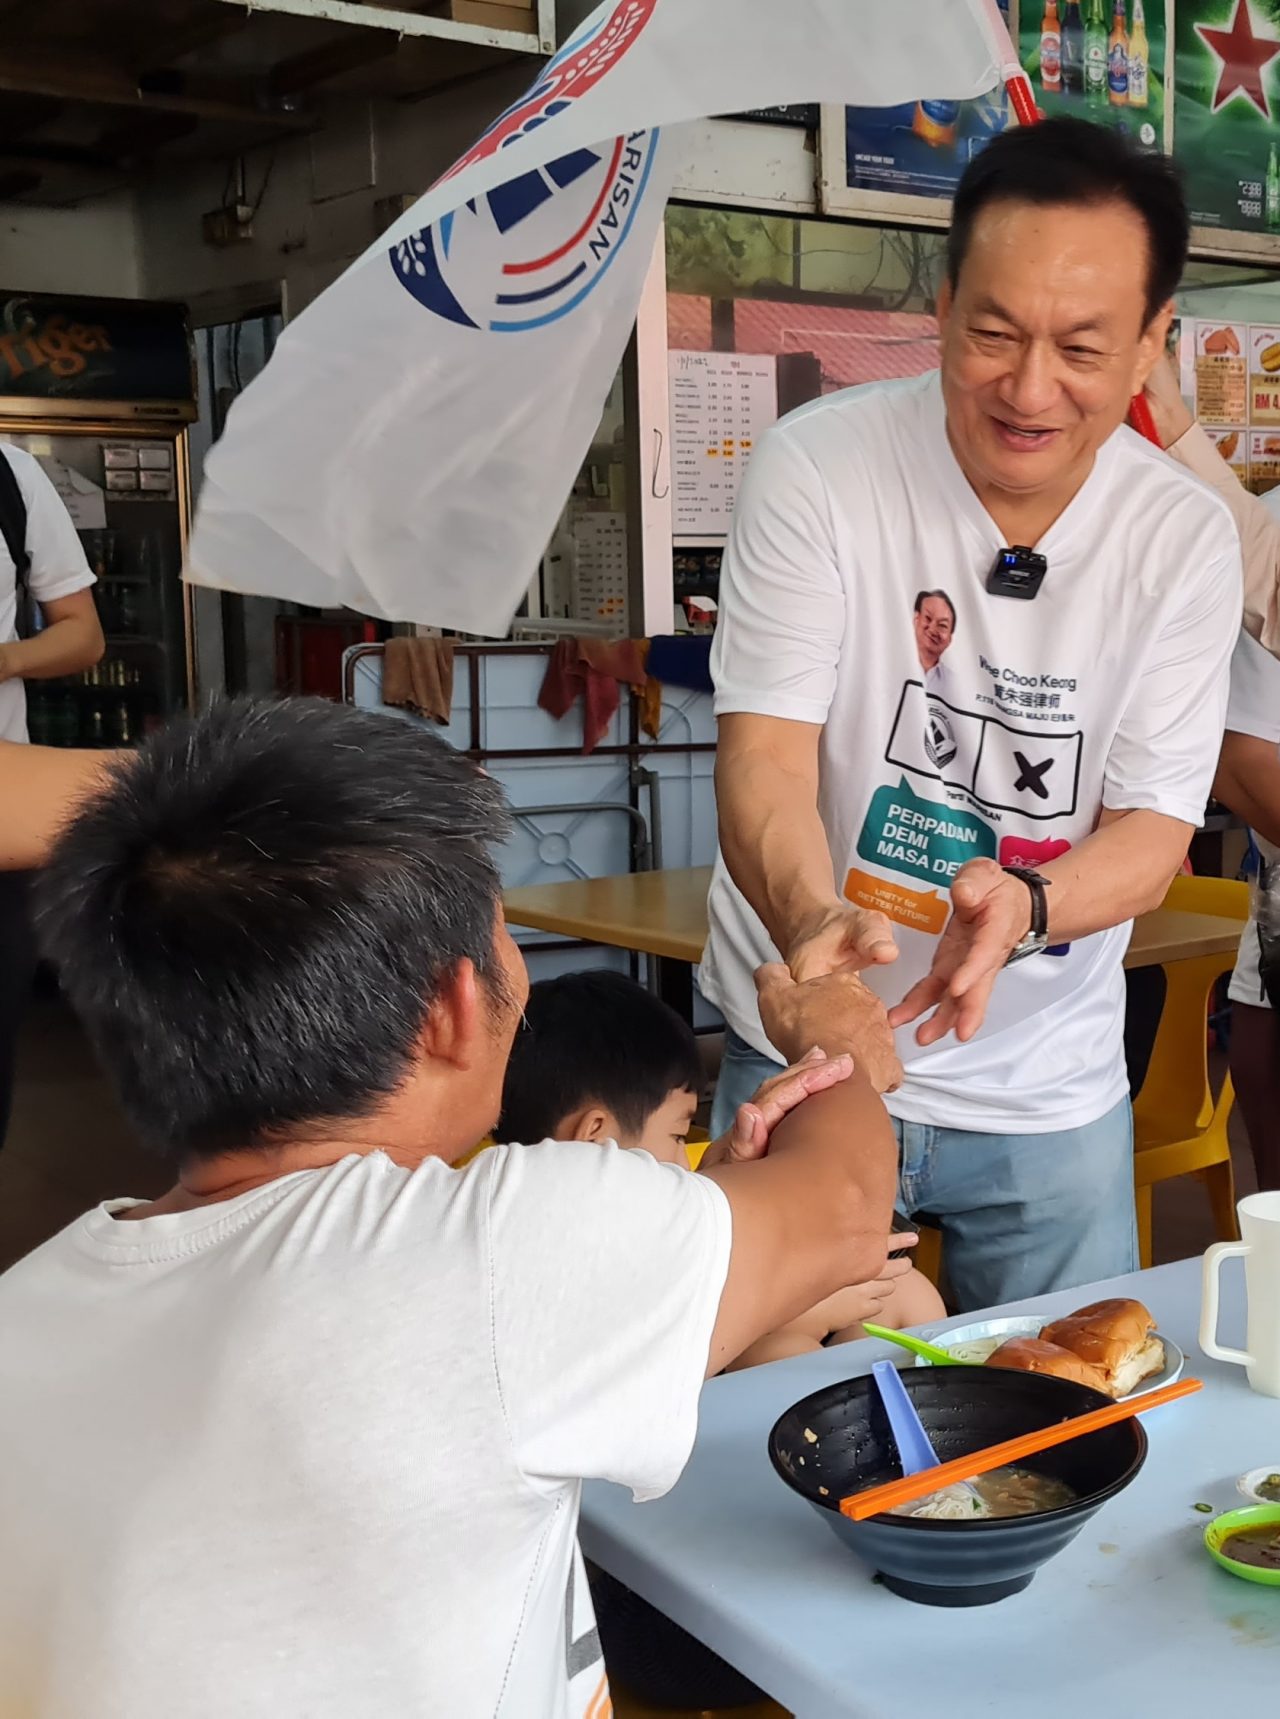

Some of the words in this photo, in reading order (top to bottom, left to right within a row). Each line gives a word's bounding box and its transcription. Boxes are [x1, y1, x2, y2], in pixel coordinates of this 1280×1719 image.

[1002, 668, 1038, 688] Choo
[882, 822, 930, 850] DEMI
[876, 840, 930, 869] MASA
[933, 859, 962, 877] DE
[894, 904, 931, 923] FUTURE
